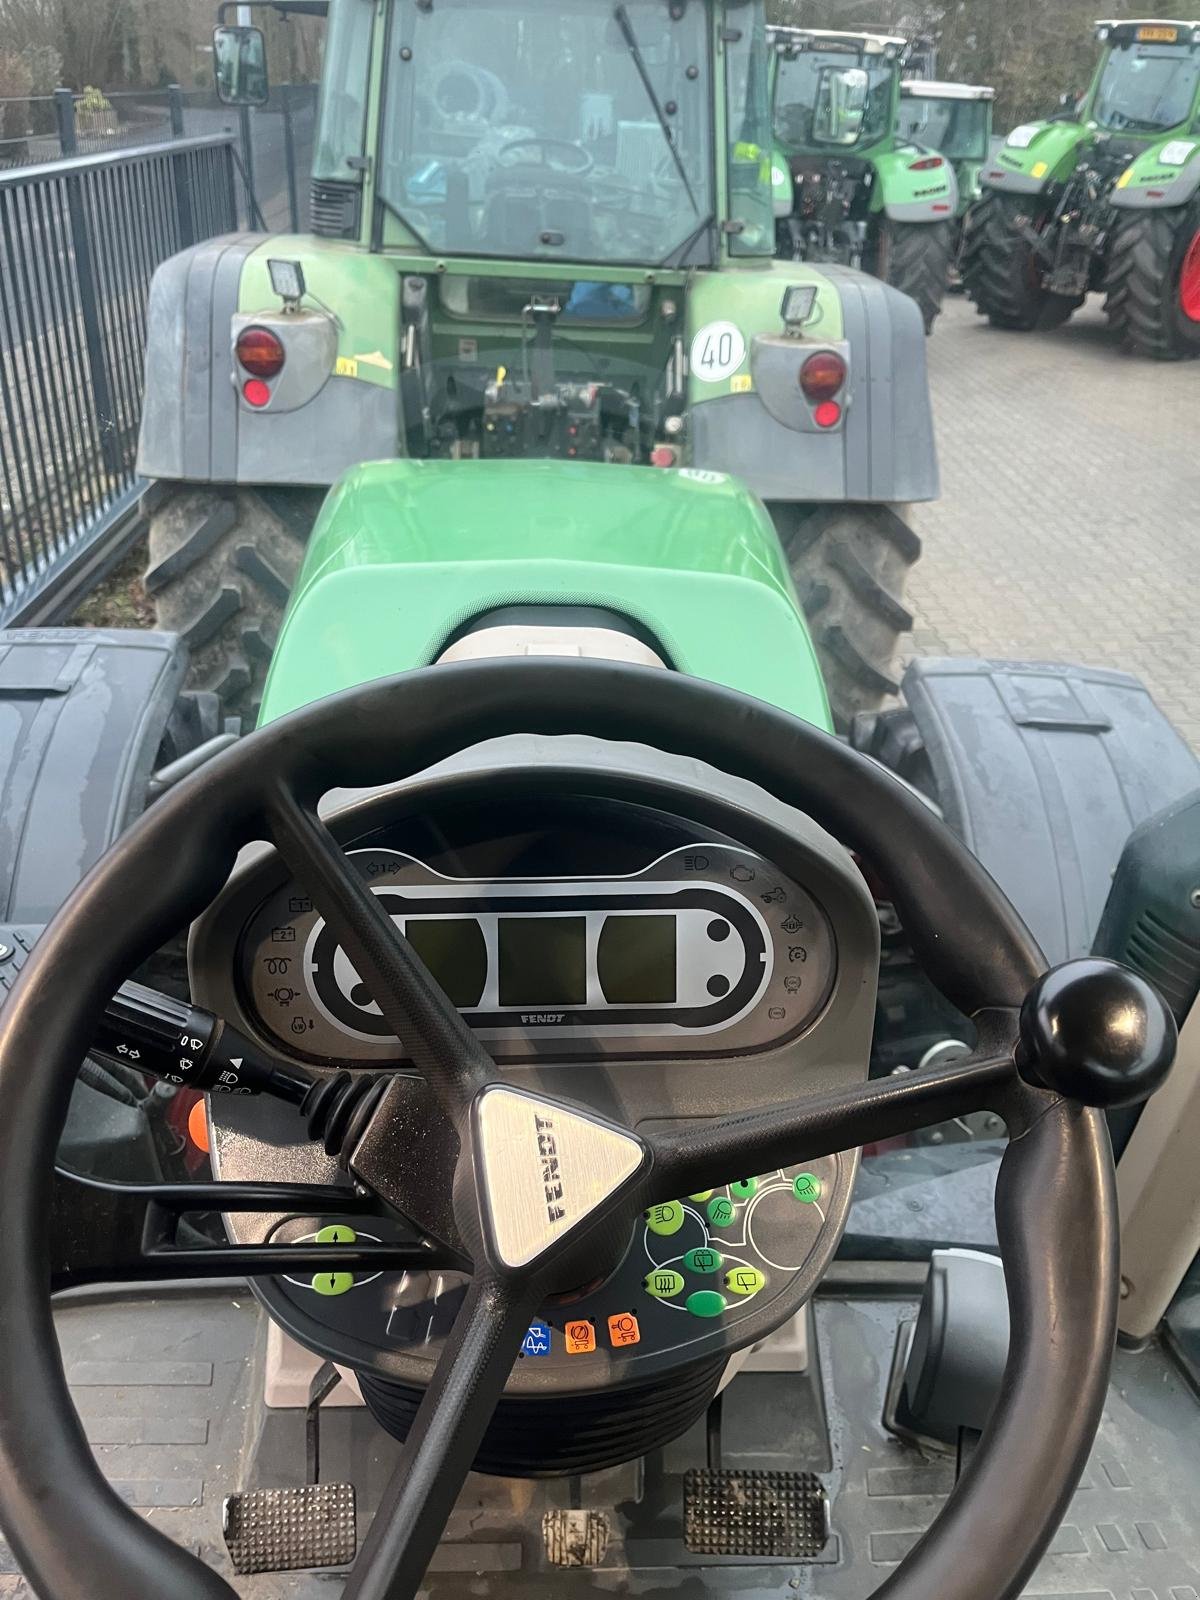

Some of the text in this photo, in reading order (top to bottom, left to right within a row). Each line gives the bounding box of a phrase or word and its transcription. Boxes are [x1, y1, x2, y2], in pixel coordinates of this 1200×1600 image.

[701, 332, 732, 369] 40
[520, 1014, 565, 1023] FENDT
[535, 1113, 566, 1222] FENDT
